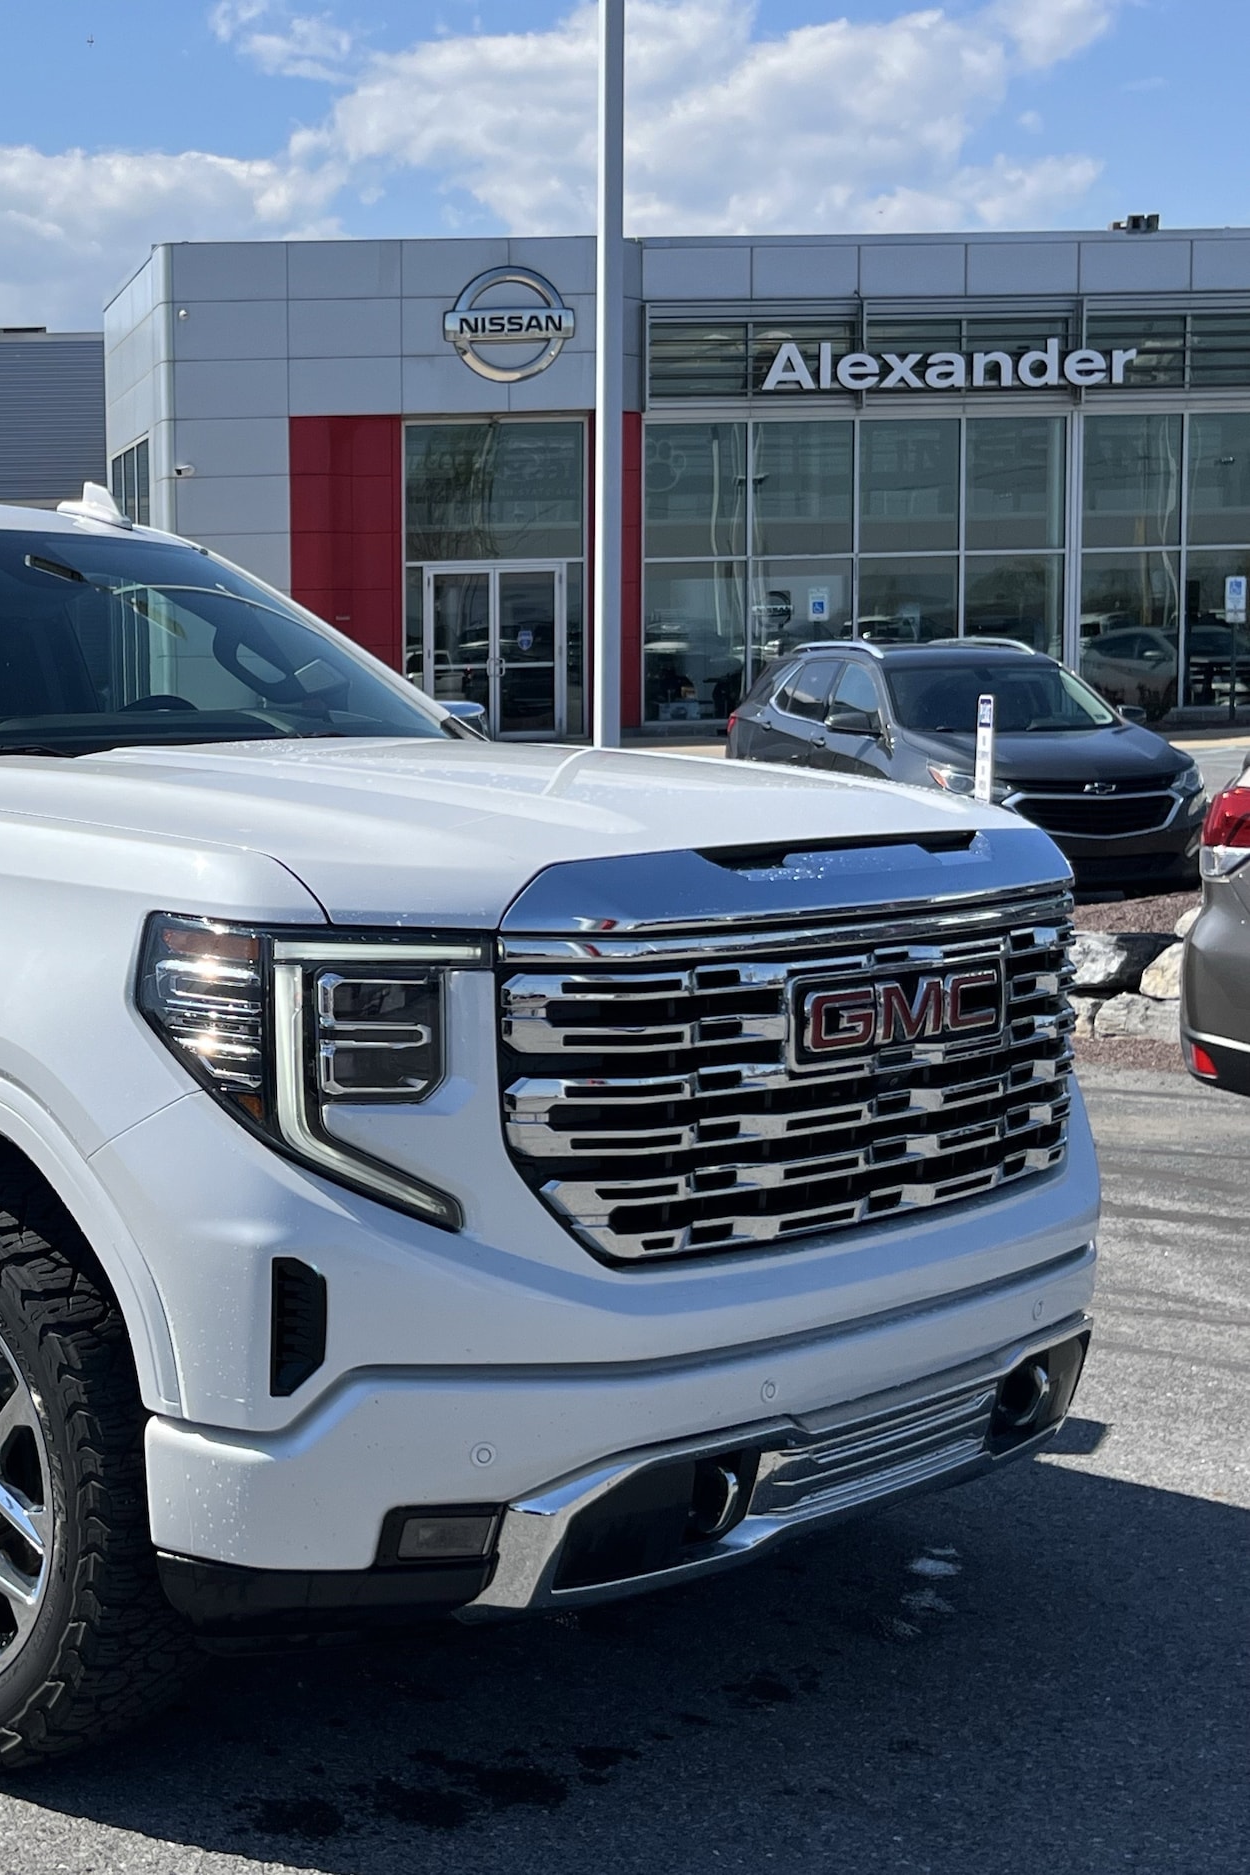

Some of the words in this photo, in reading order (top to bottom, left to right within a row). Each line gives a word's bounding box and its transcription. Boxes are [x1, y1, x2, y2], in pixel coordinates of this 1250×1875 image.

[459, 315, 562, 334] NISSAN
[761, 337, 1137, 391] Alexander
[804, 970, 997, 1052] GMC
